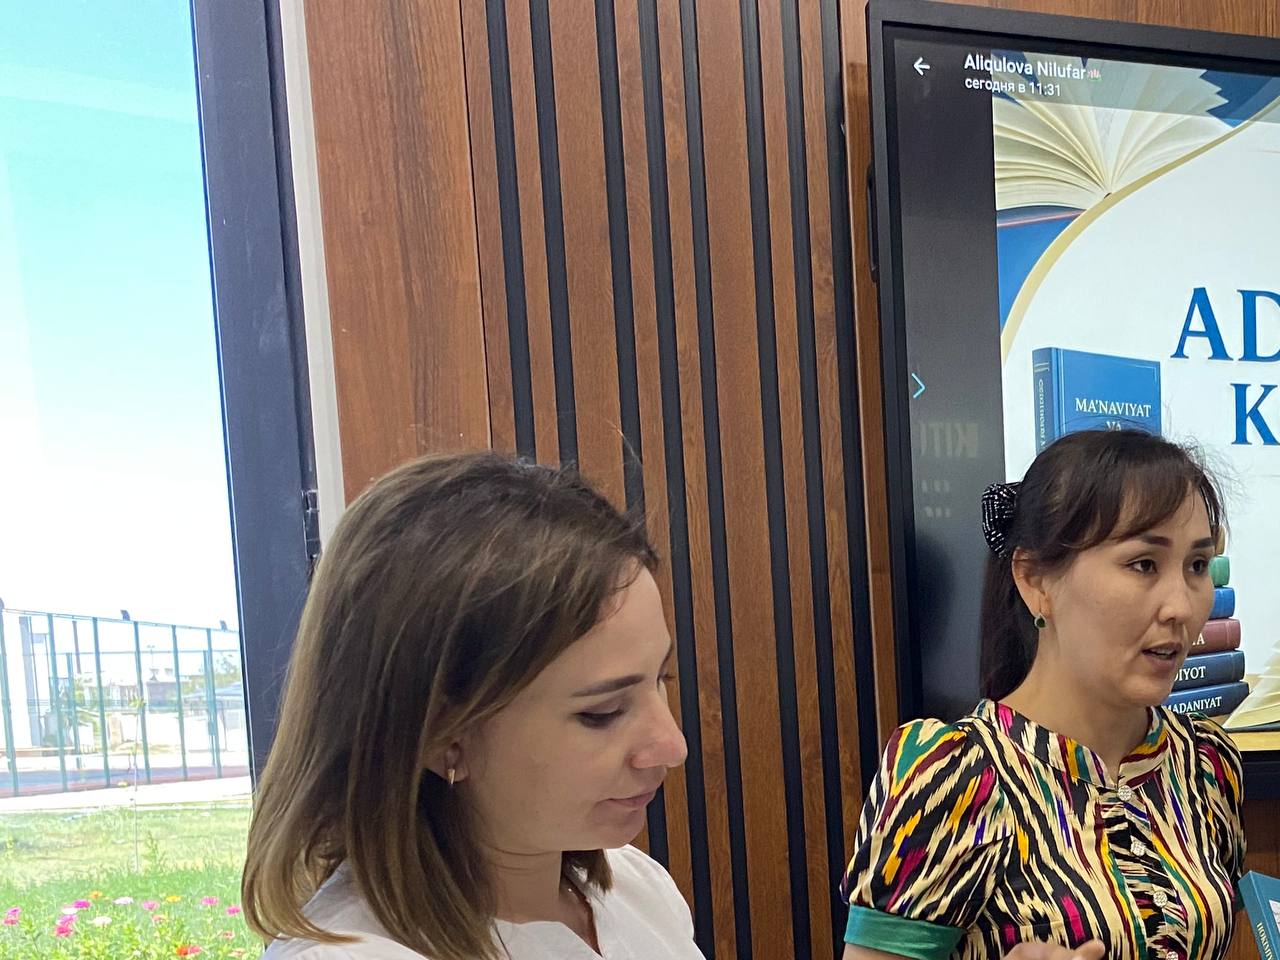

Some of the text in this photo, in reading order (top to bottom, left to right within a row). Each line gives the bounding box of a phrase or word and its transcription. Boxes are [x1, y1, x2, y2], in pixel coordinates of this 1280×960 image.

[964, 53, 1086, 80] Aliqulova Nilufar
[965, 78, 1060, 96] сегодня в 11:31
